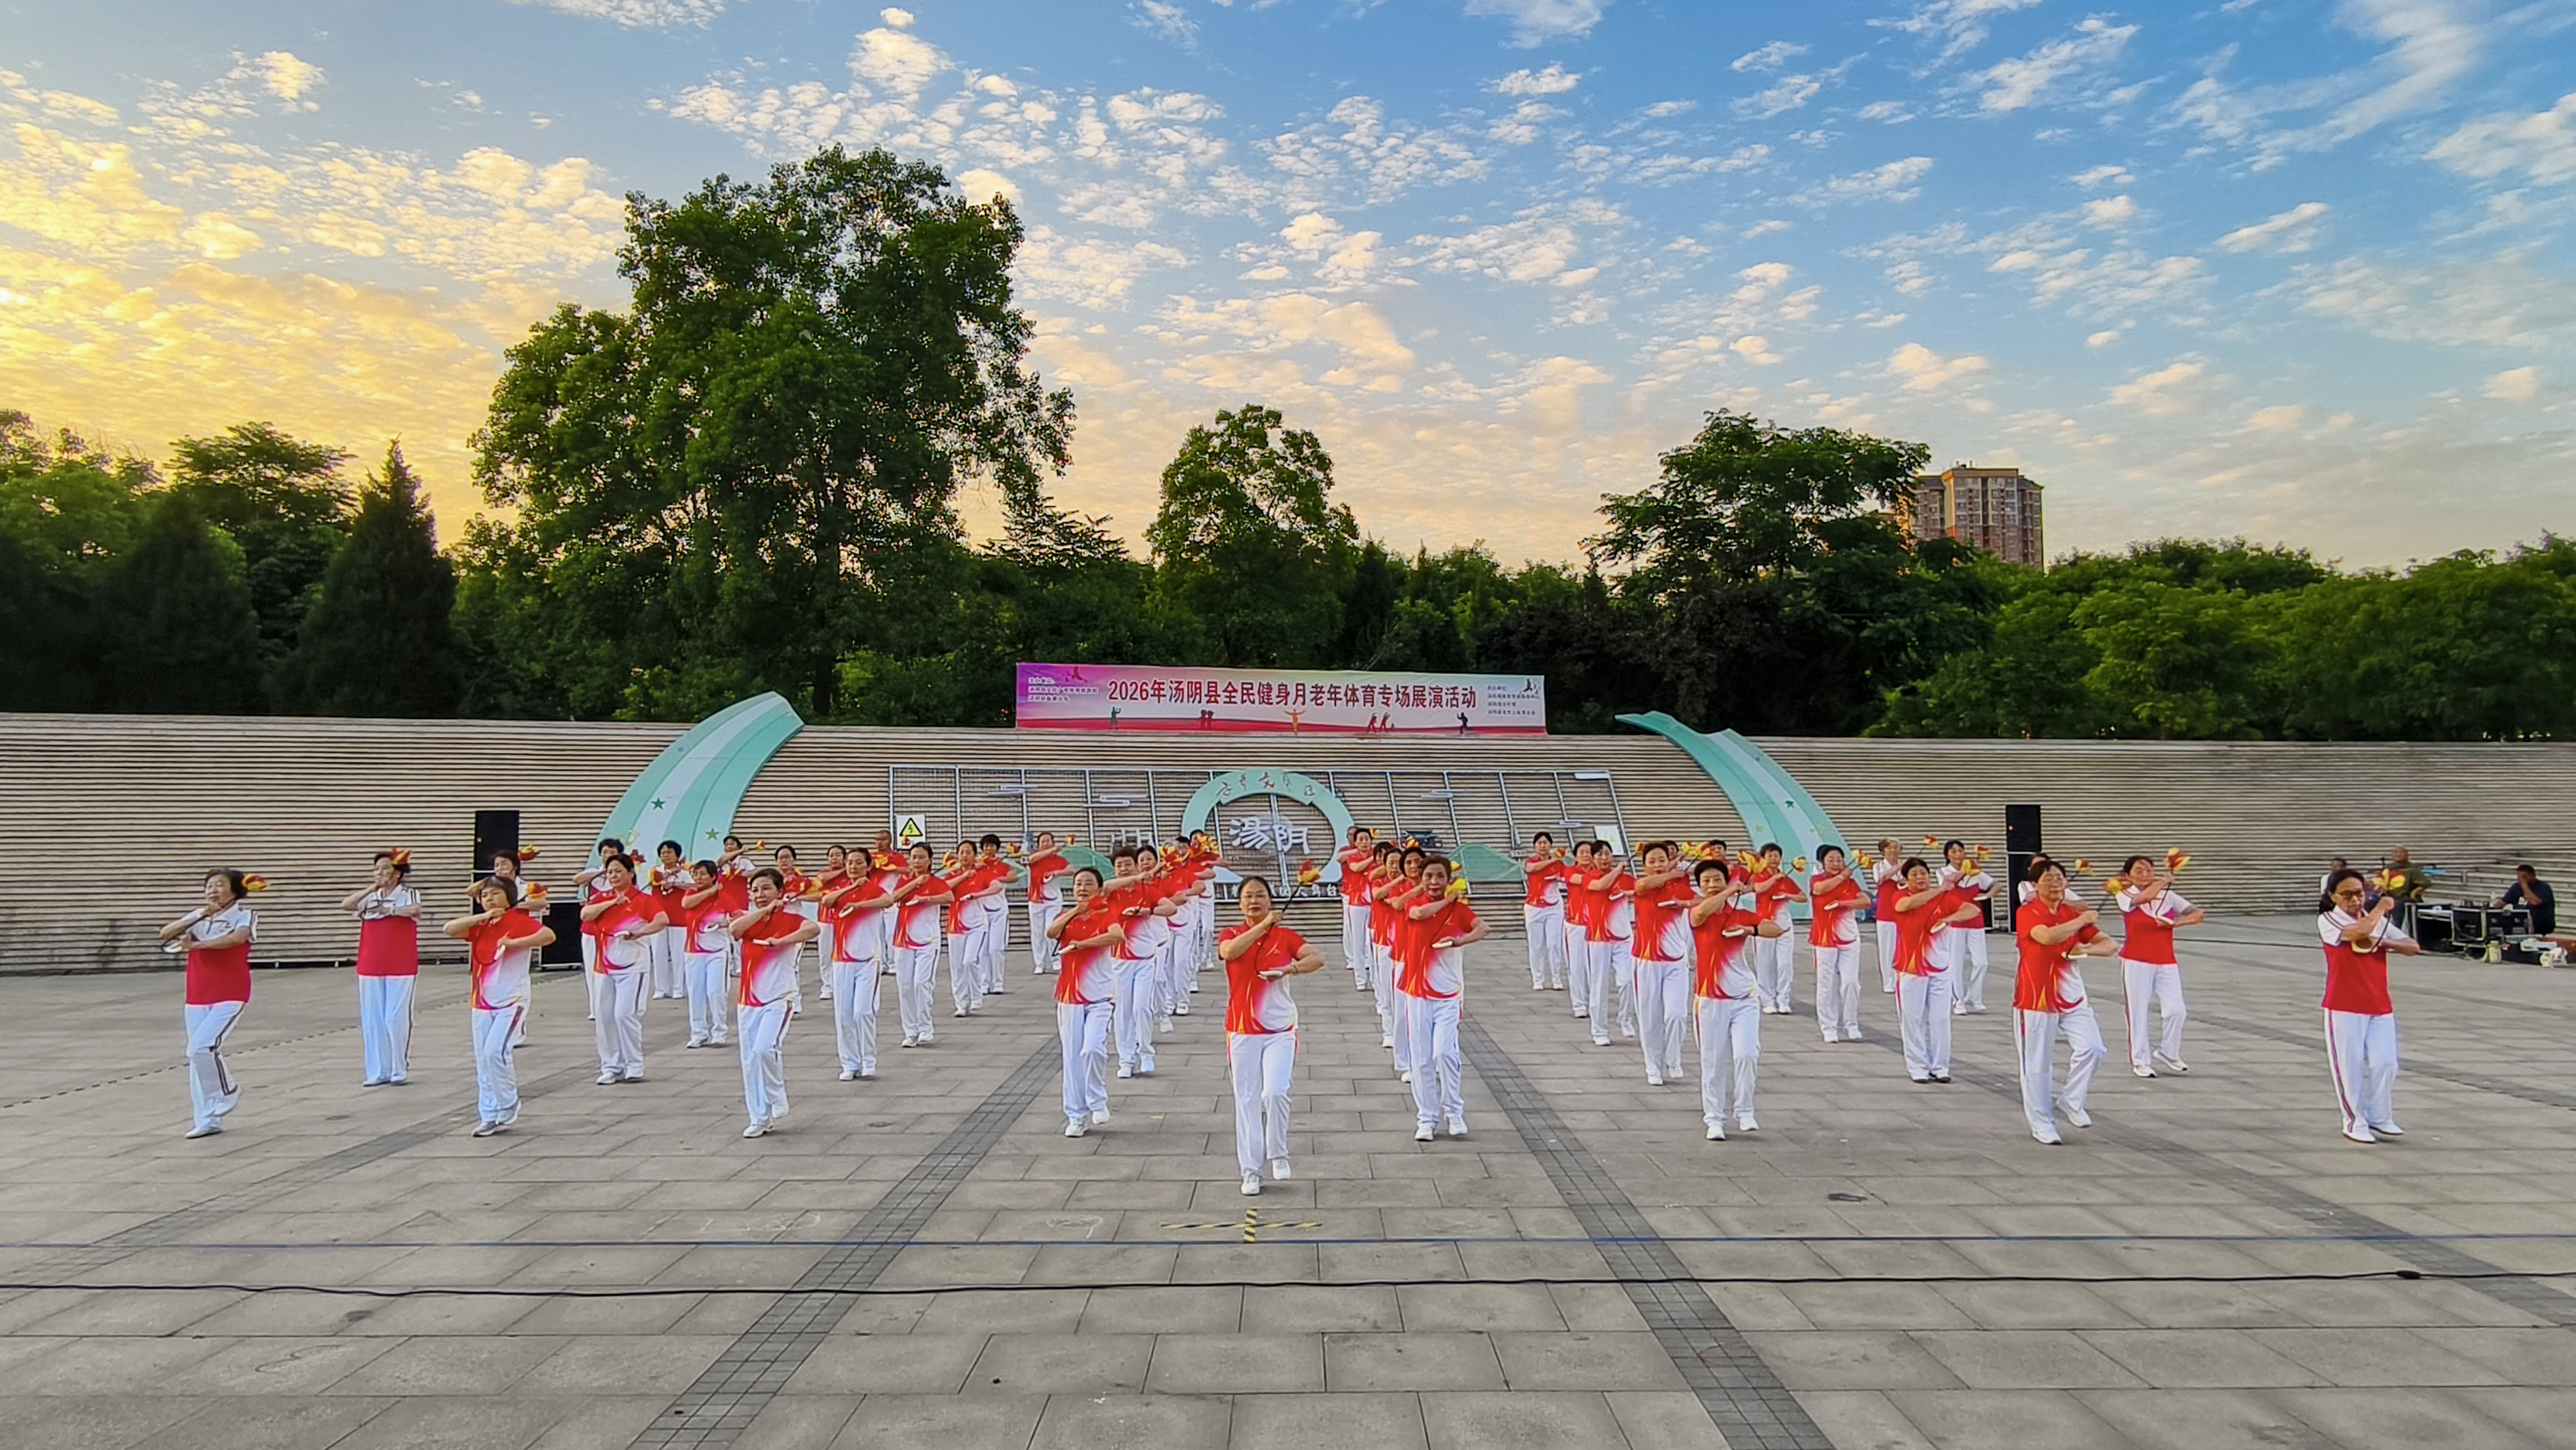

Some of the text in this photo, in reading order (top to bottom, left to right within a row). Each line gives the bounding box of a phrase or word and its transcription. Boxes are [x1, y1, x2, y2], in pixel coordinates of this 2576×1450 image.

[1108, 680, 1477, 708] 2026年汤阴县全民健身月老年体育专场展演活动
